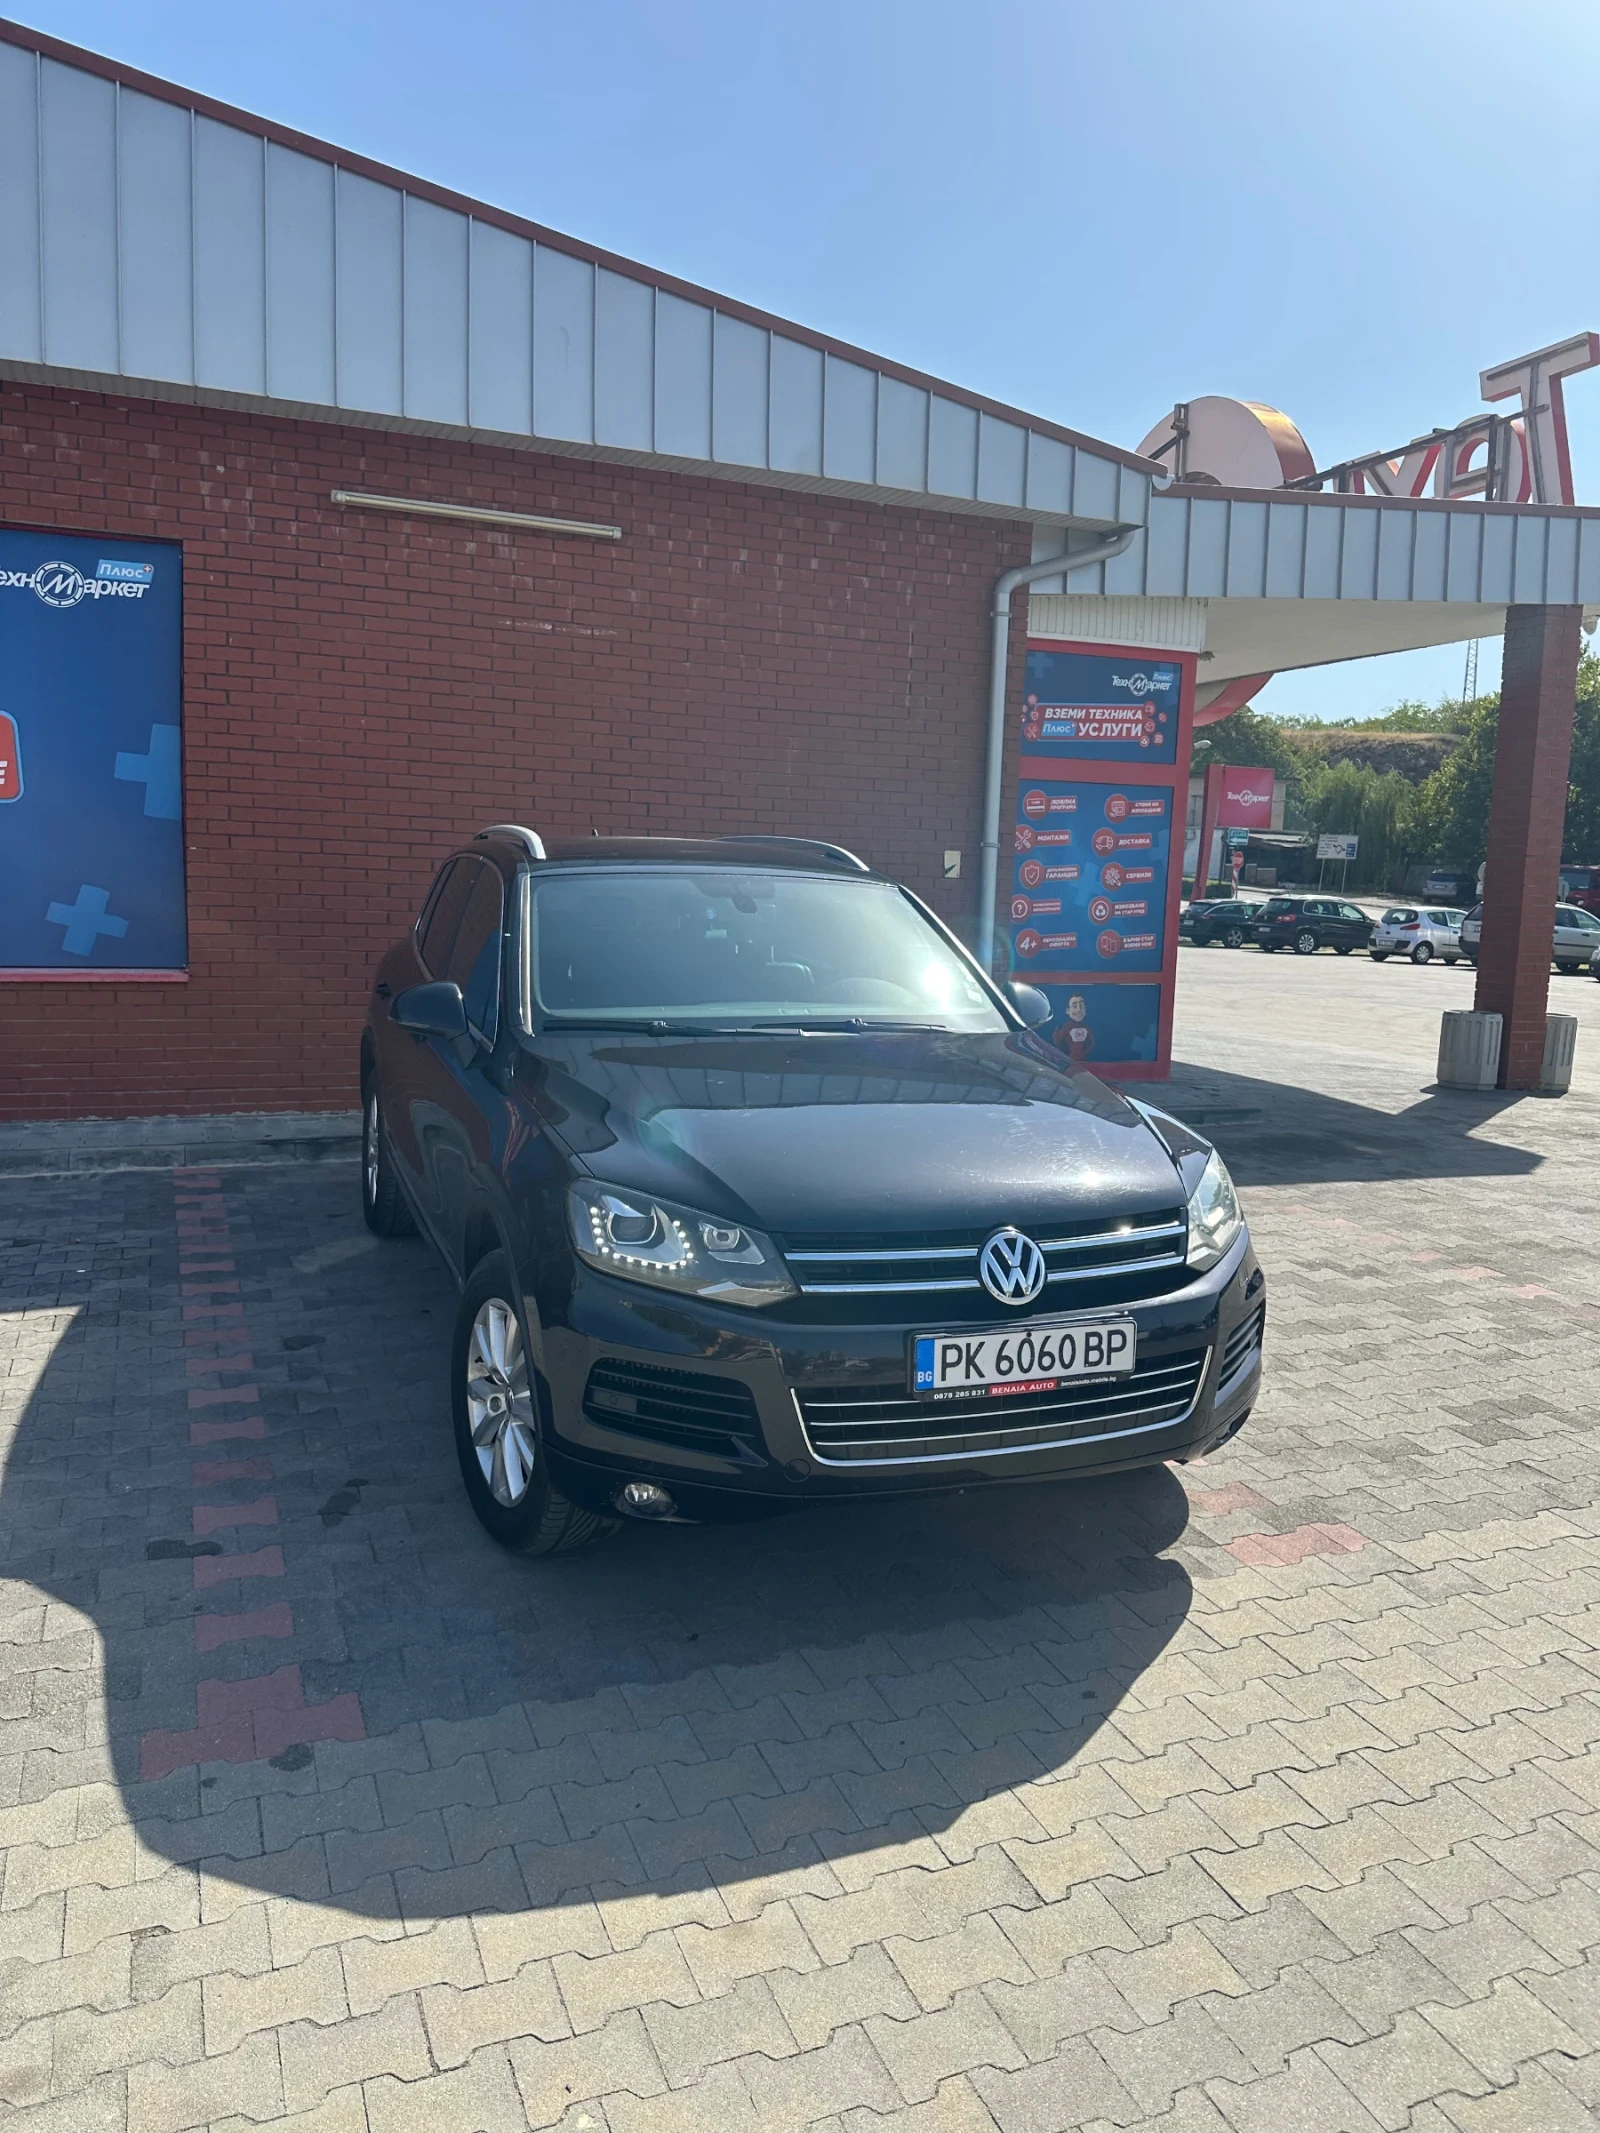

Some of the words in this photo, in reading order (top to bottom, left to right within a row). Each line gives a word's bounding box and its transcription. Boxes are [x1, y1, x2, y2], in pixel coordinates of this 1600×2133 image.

[1045, 708, 1086, 719] ВЗЕМИ
[1089, 709, 1142, 720] ТЕХНИКА
[1078, 723, 1142, 736] УСЛУГИ
[1119, 838, 1150, 846] ДОСТАВКА
[996, 1334, 1076, 1376] 6060
[918, 1371, 933, 1382] BG
[992, 1385, 1025, 1395] BENAIA
[1030, 1382, 1054, 1390] AUTO
[934, 1392, 953, 1400] 0878
